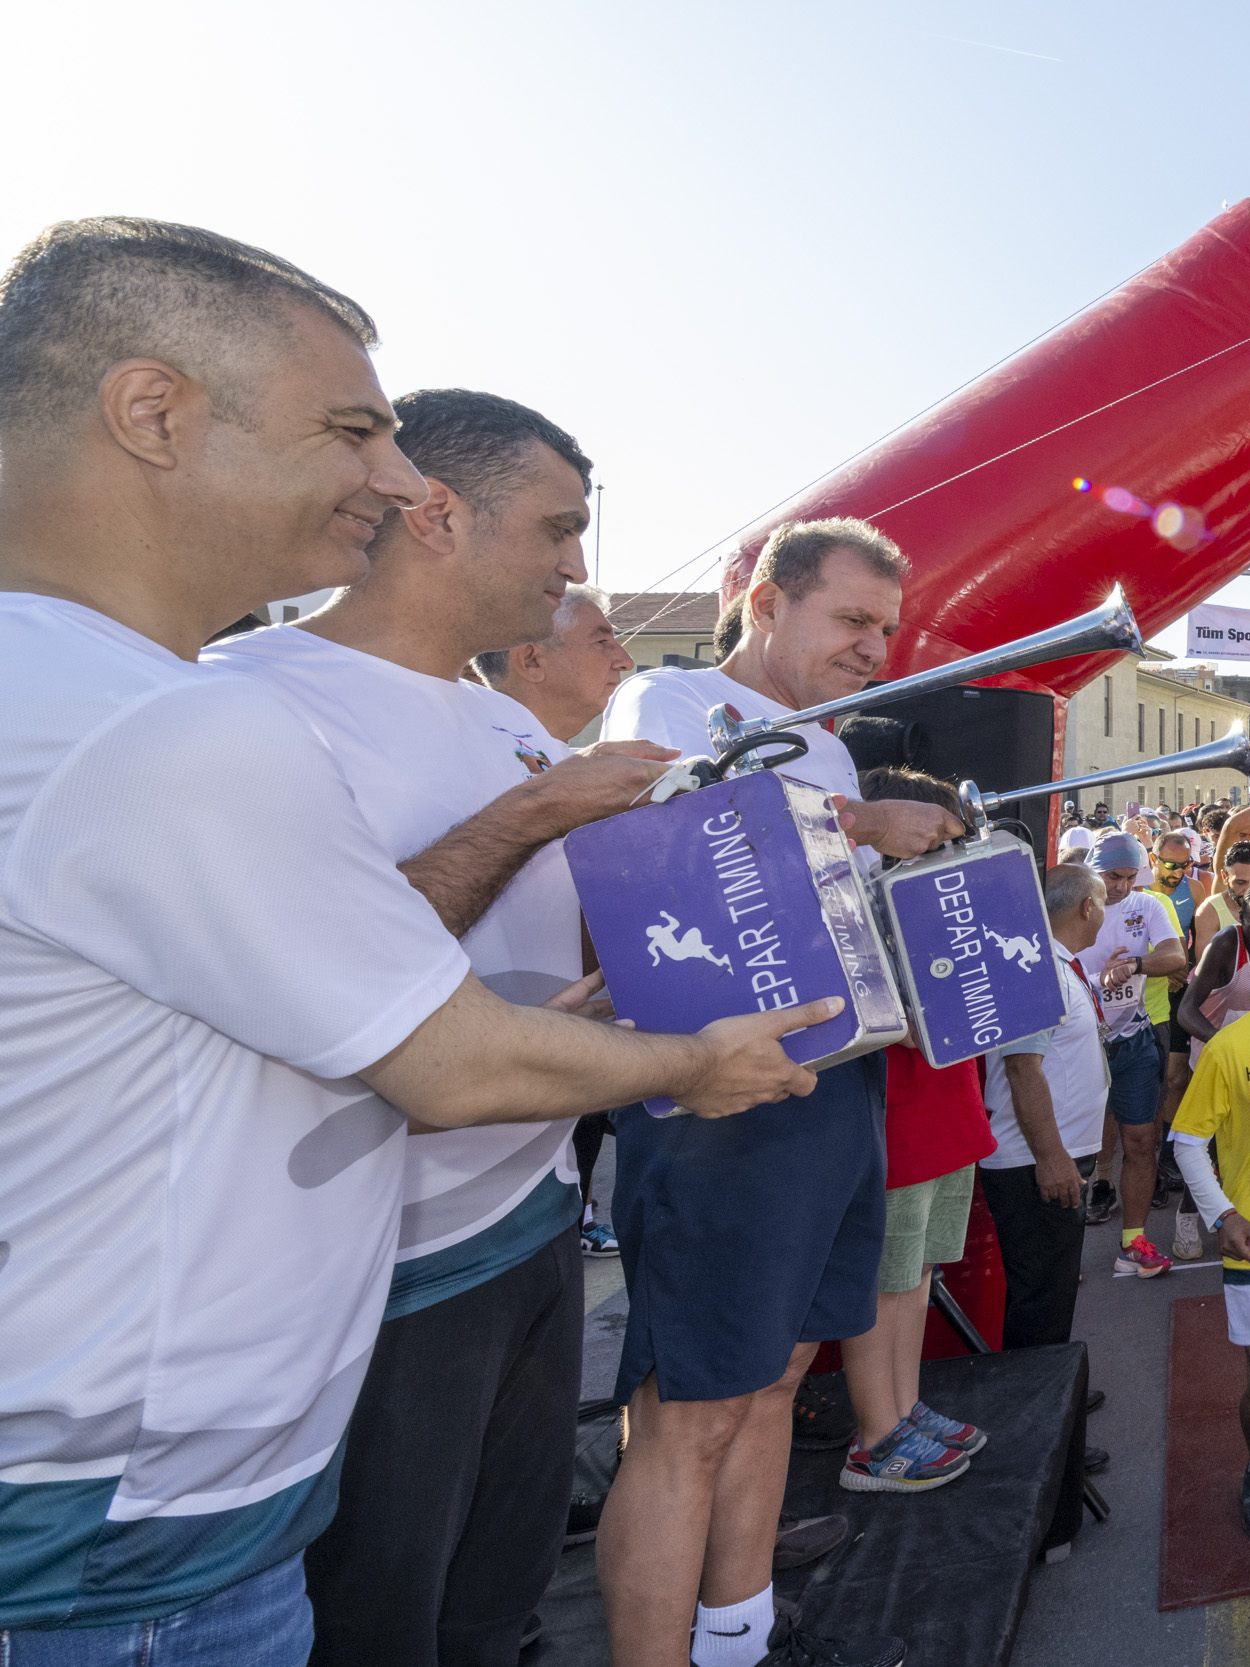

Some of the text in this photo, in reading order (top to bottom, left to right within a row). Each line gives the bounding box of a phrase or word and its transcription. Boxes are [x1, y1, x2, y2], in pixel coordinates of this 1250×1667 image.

[1196, 626, 1224, 640] Tüm
[702, 810, 800, 1016] EPAR TIMING
[797, 810, 871, 998] DEPAR TIMING
[934, 871, 1003, 1046] DEPAR TIMING
[1102, 986, 1134, 1002] 356
